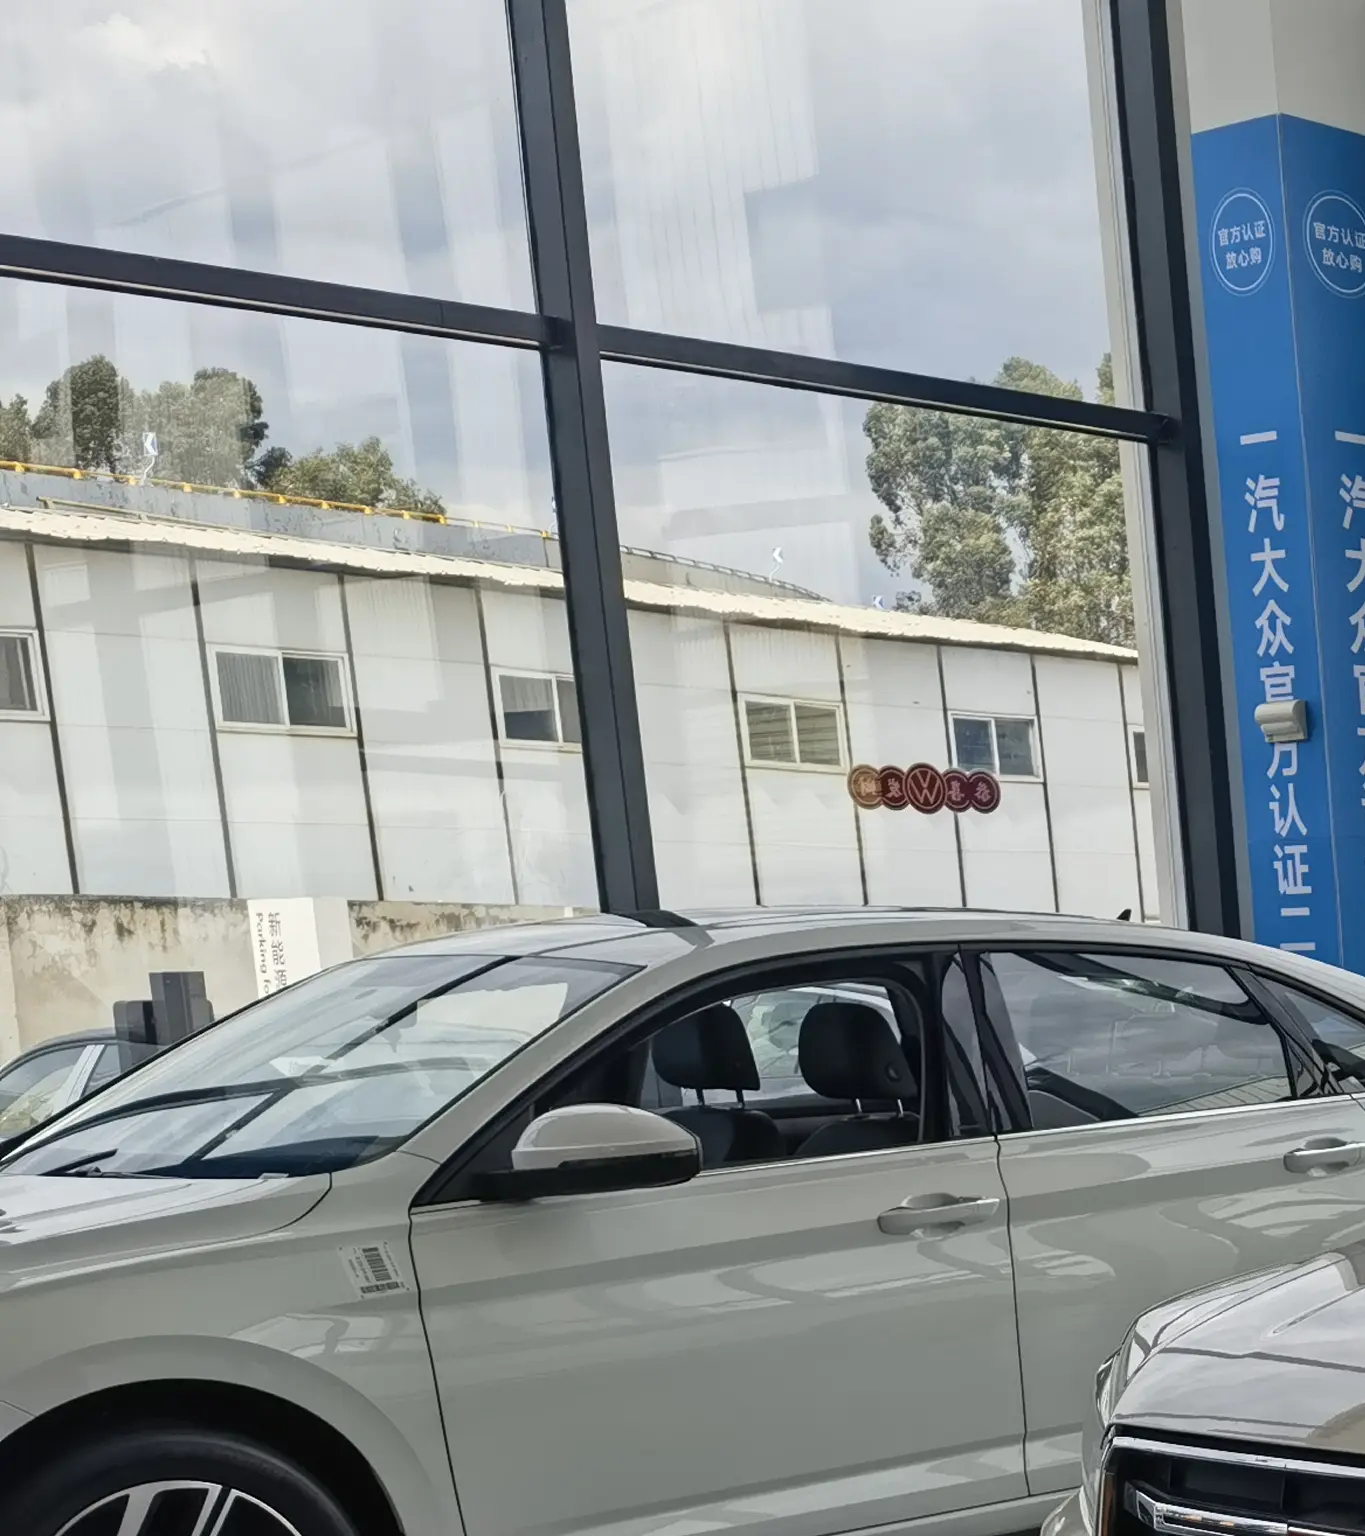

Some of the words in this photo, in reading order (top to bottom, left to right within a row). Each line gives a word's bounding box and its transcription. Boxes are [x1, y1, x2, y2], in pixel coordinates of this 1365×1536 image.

[1217, 219, 1267, 248] 官方认证
[1225, 246, 1263, 269] 放心购
[1321, 247, 1364, 273] 放心购
[255, 912, 268, 974] Parking
